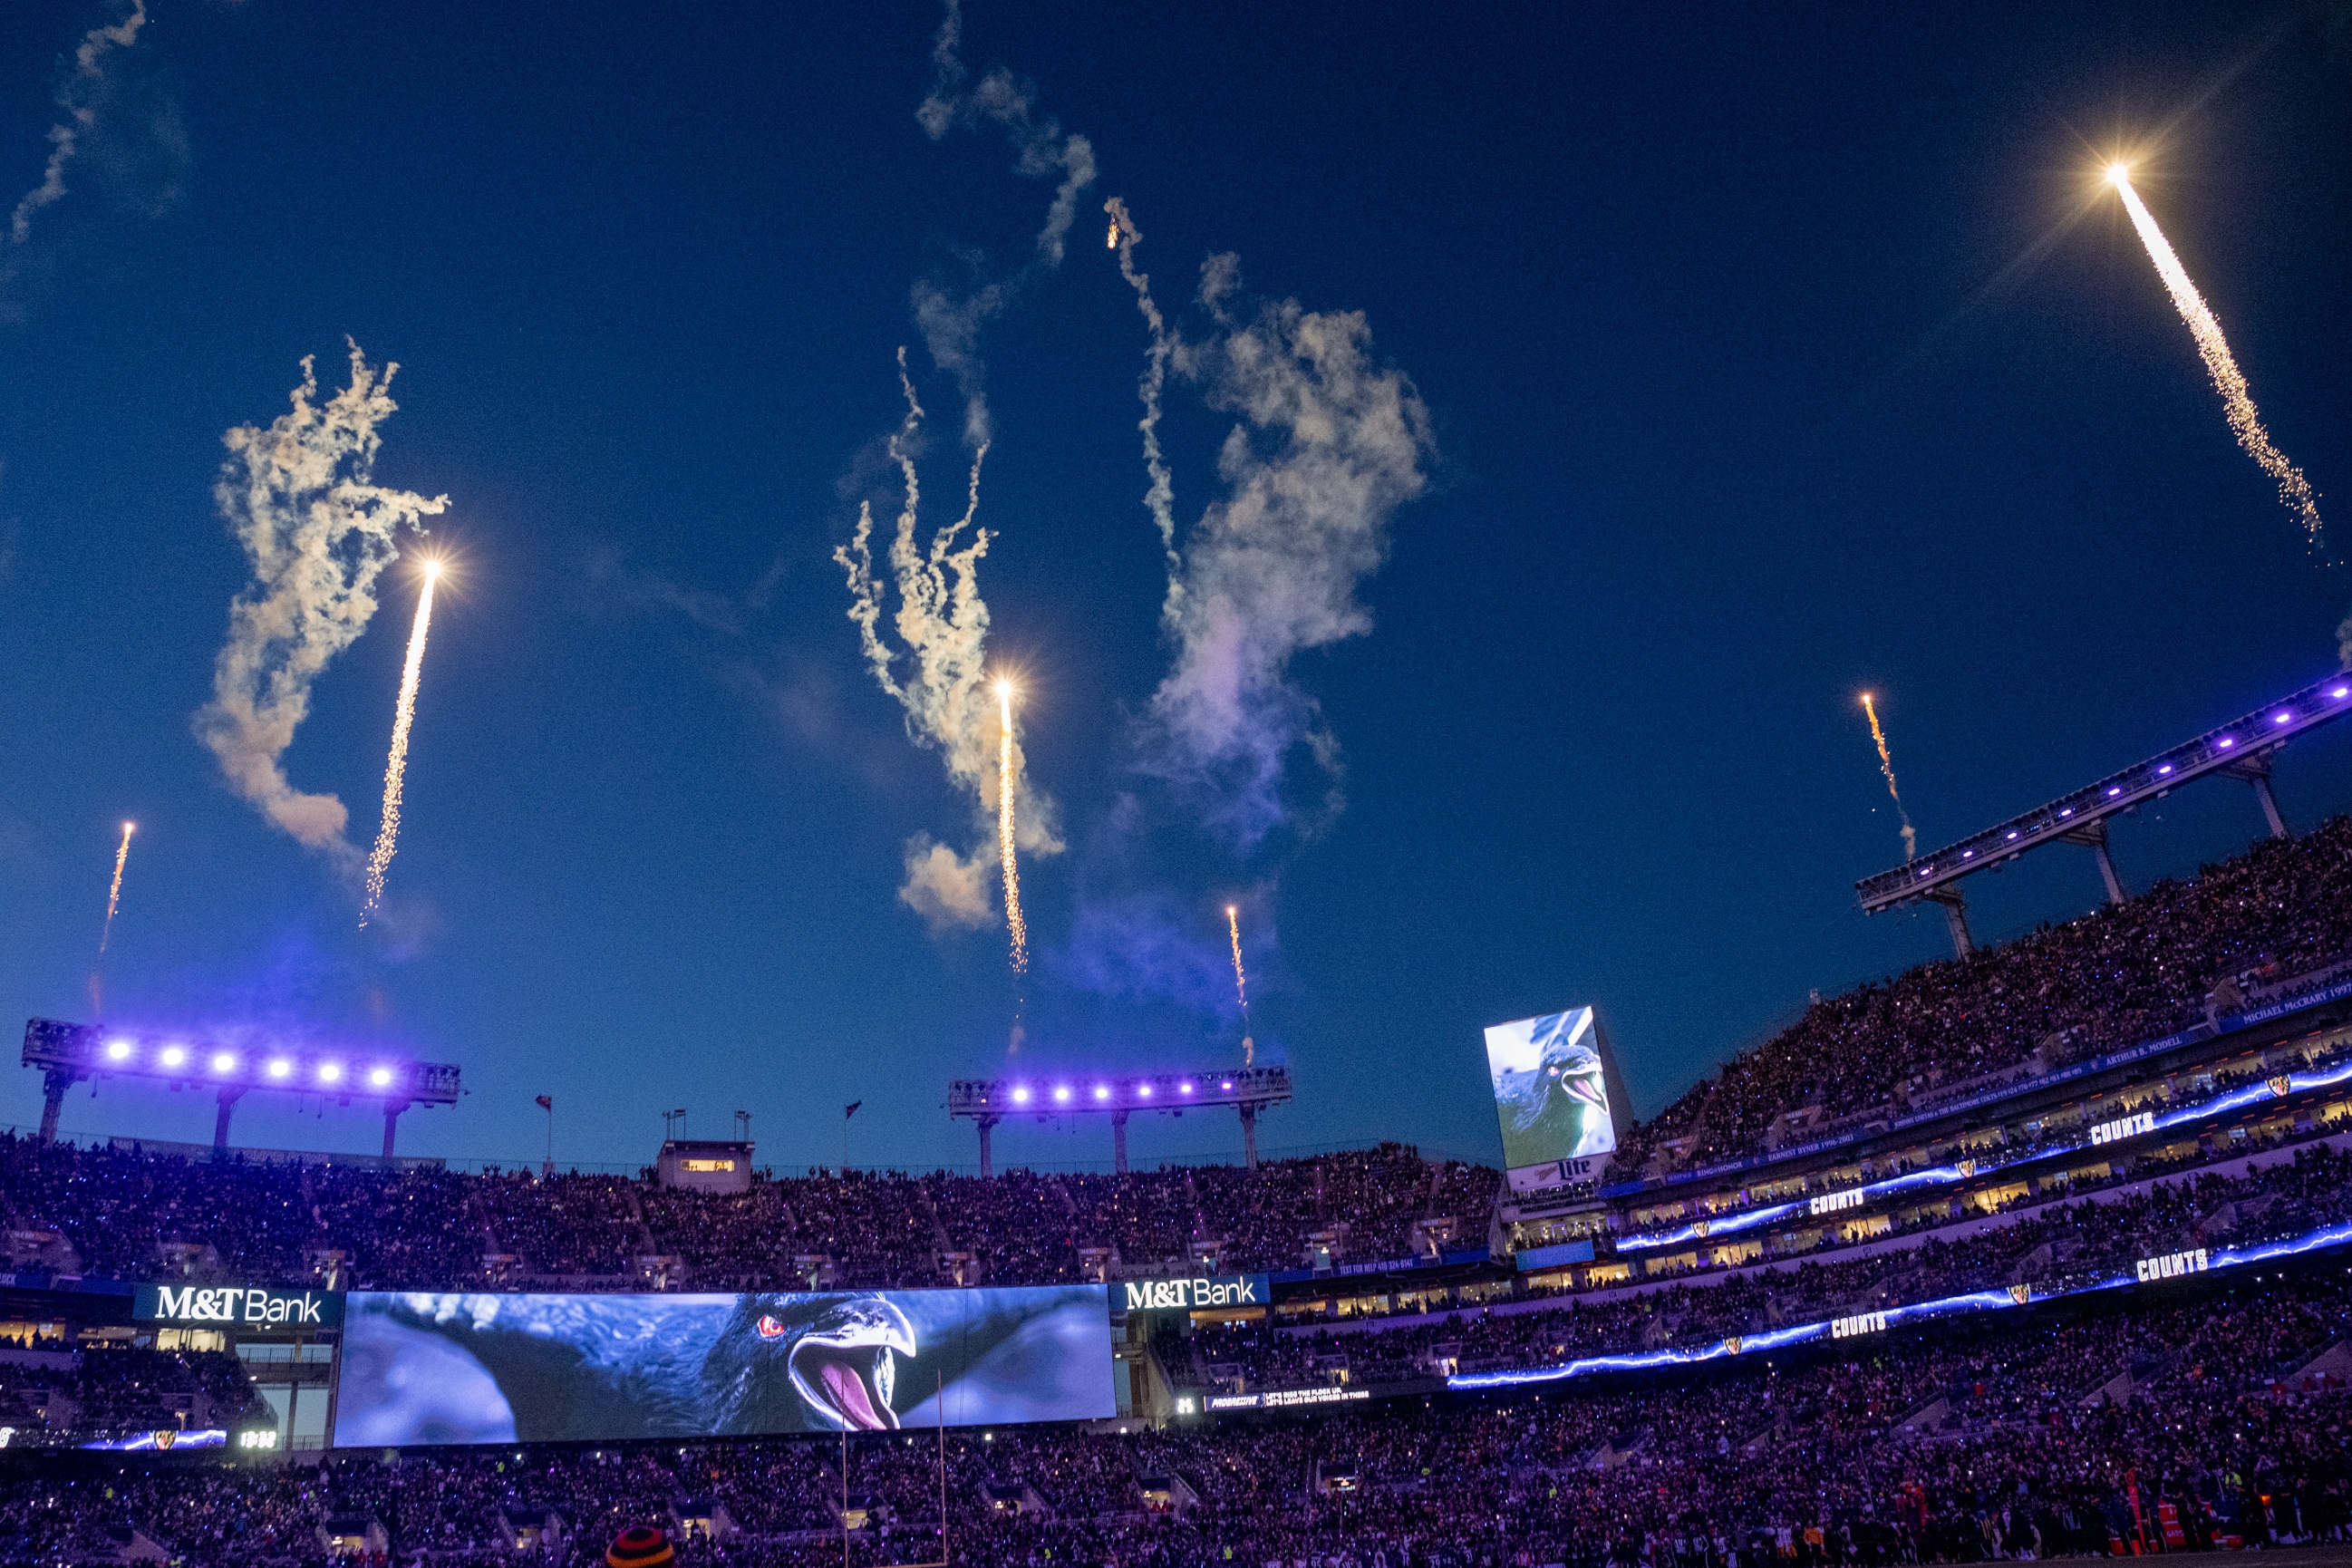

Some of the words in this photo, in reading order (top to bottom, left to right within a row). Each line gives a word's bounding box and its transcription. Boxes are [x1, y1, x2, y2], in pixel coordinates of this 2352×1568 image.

[2243, 1005, 2284, 1024] MICHAEL
[2106, 1050, 2138, 1067] ARTHUR
[2139, 1047, 2148, 1057] B.
[2149, 1036, 2183, 1053] MODELL
[1980, 1092, 1998, 1103] COLTS
[2091, 1111, 2154, 1146] COUNTS
[1767, 1148, 1796, 1162] EARNEST
[1797, 1142, 1820, 1156] BYNER
[1558, 1159, 1591, 1181] Lite
[1697, 1167, 1714, 1177] RING
[1718, 1161, 1743, 1174] HONOR
[1811, 1186, 1863, 1215] COUNTS
[2136, 1248, 2209, 1282] COUNTS
[154, 1285, 245, 1321] M&T
[245, 1289, 322, 1322] Bank
[1125, 1279, 1191, 1311] M&T
[1193, 1276, 1256, 1306] Bank
[1832, 1311, 1885, 1339] COUNTS
[1211, 1396, 1258, 1408] PROGRESSIVE
